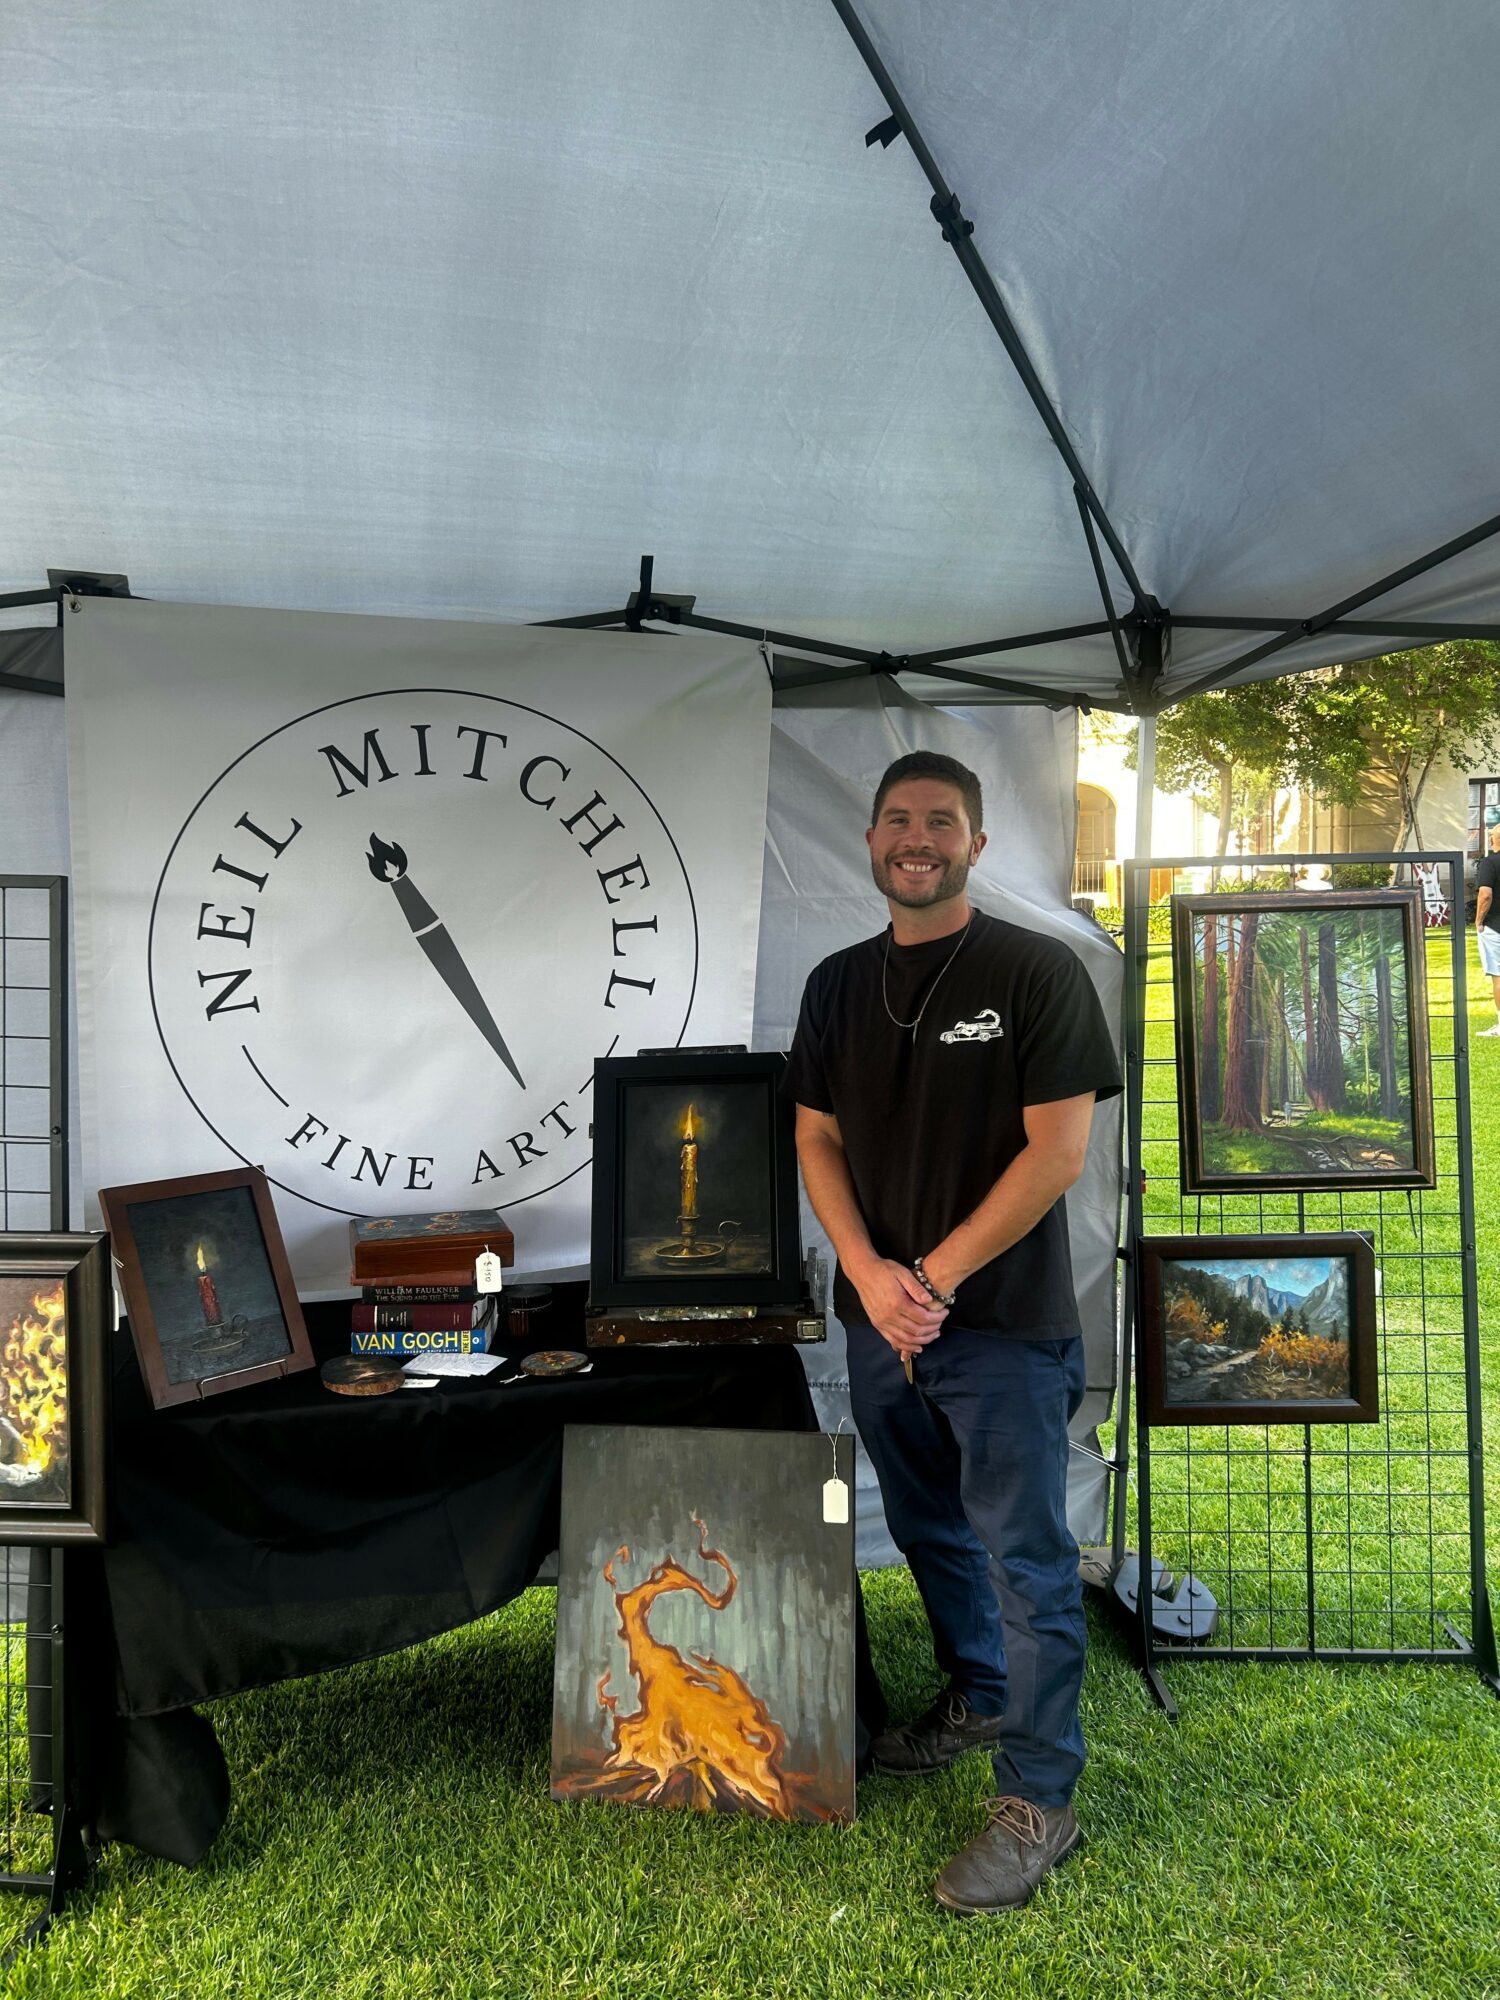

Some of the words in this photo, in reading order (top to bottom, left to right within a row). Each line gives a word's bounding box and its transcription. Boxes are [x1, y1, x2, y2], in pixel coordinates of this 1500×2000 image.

[197, 811, 303, 1022] NEIL
[318, 724, 658, 1009] MITCHELL
[284, 1112, 434, 1190] FINE
[471, 1100, 577, 1185] ART
[375, 1287, 413, 1295] WILLIAM
[415, 1286, 459, 1294] FAULKNER
[355, 1333, 395, 1351] VAN
[402, 1331, 458, 1349] GOGH
[462, 1342, 470, 1352] THE
